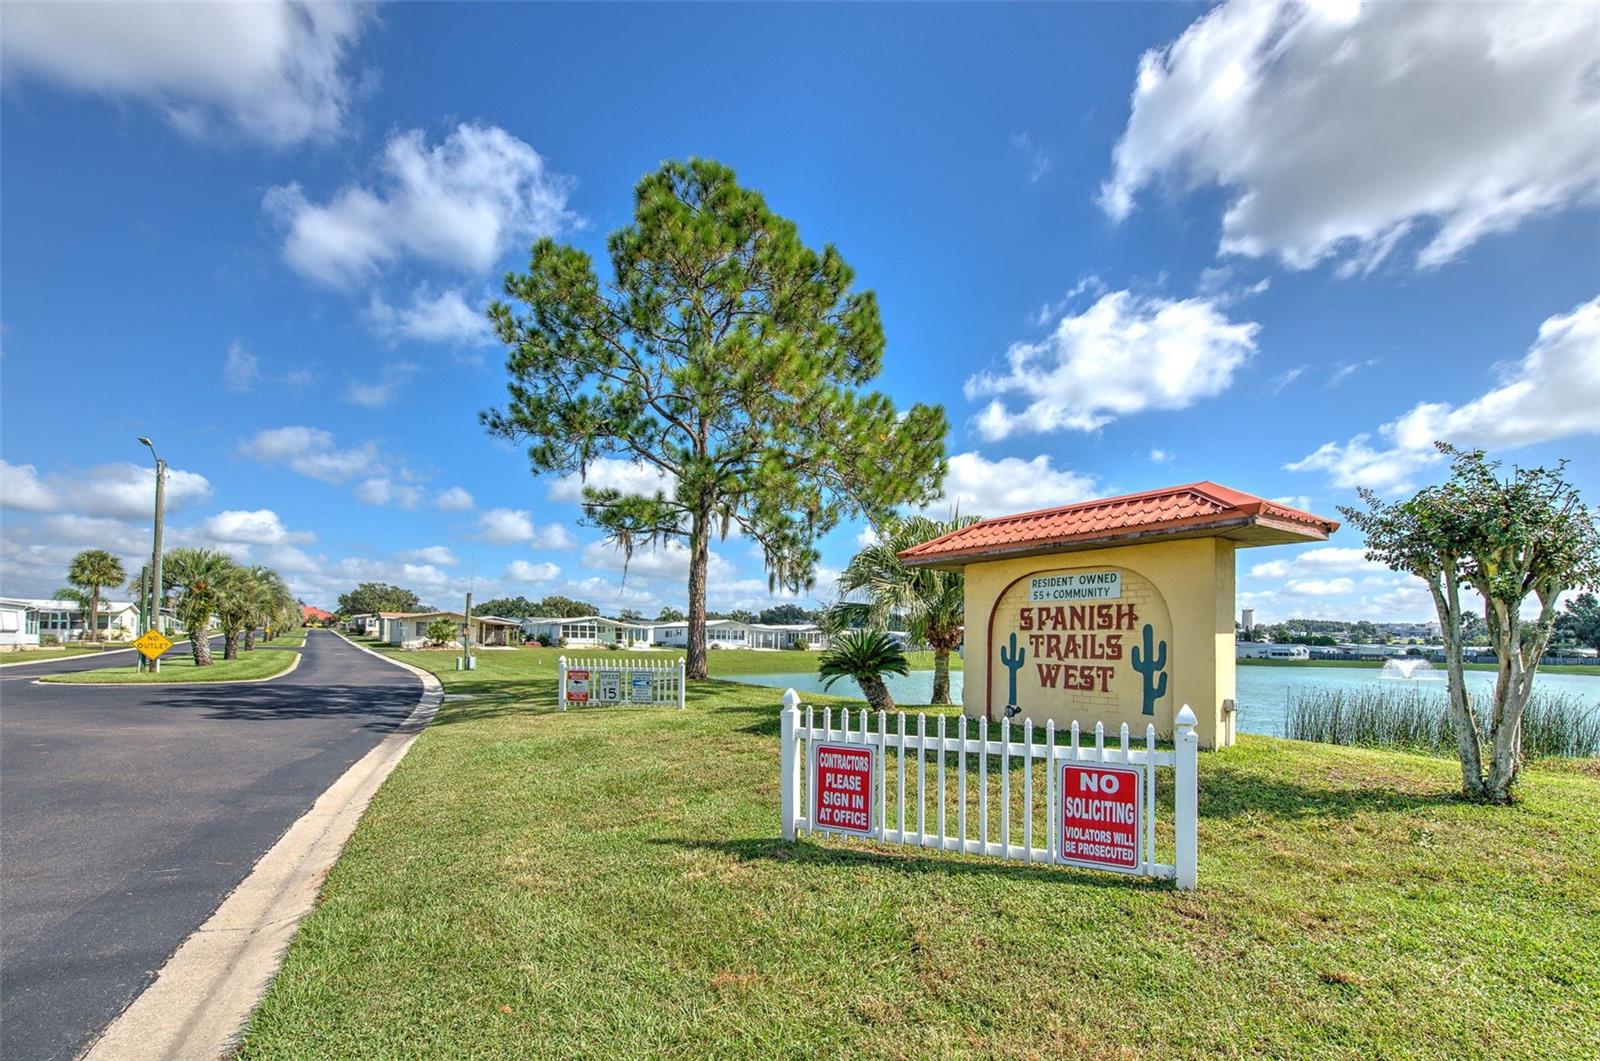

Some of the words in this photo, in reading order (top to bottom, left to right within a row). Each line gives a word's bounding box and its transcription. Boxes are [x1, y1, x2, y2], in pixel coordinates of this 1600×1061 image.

[1032, 576, 1073, 588] RESIDENT
[1079, 573, 1117, 585] OWNED
[1033, 590, 1050, 600] 55+
[1053, 587, 1110, 599] COMMUNITY
[1019, 604, 1138, 630] SPANISH
[1029, 634, 1123, 661] TRAILS
[1036, 663, 1114, 693] WEST
[603, 688, 617, 699] 15
[819, 752, 869, 772] CONTRACTORS
[825, 773, 861, 790] PLEASE
[1080, 772, 1119, 794] NO
[823, 790, 849, 807] SIGN
[852, 795, 864, 809] IN
[819, 807, 832, 821] AT
[833, 809, 867, 826] OFFICE
[1065, 797, 1134, 824] SOLICITING
[1065, 826, 1112, 844] VIOLATORS
[1113, 832, 1134, 846] WILL
[1065, 841, 1076, 853] BE
[1078, 843, 1134, 861] PROSECUTED
